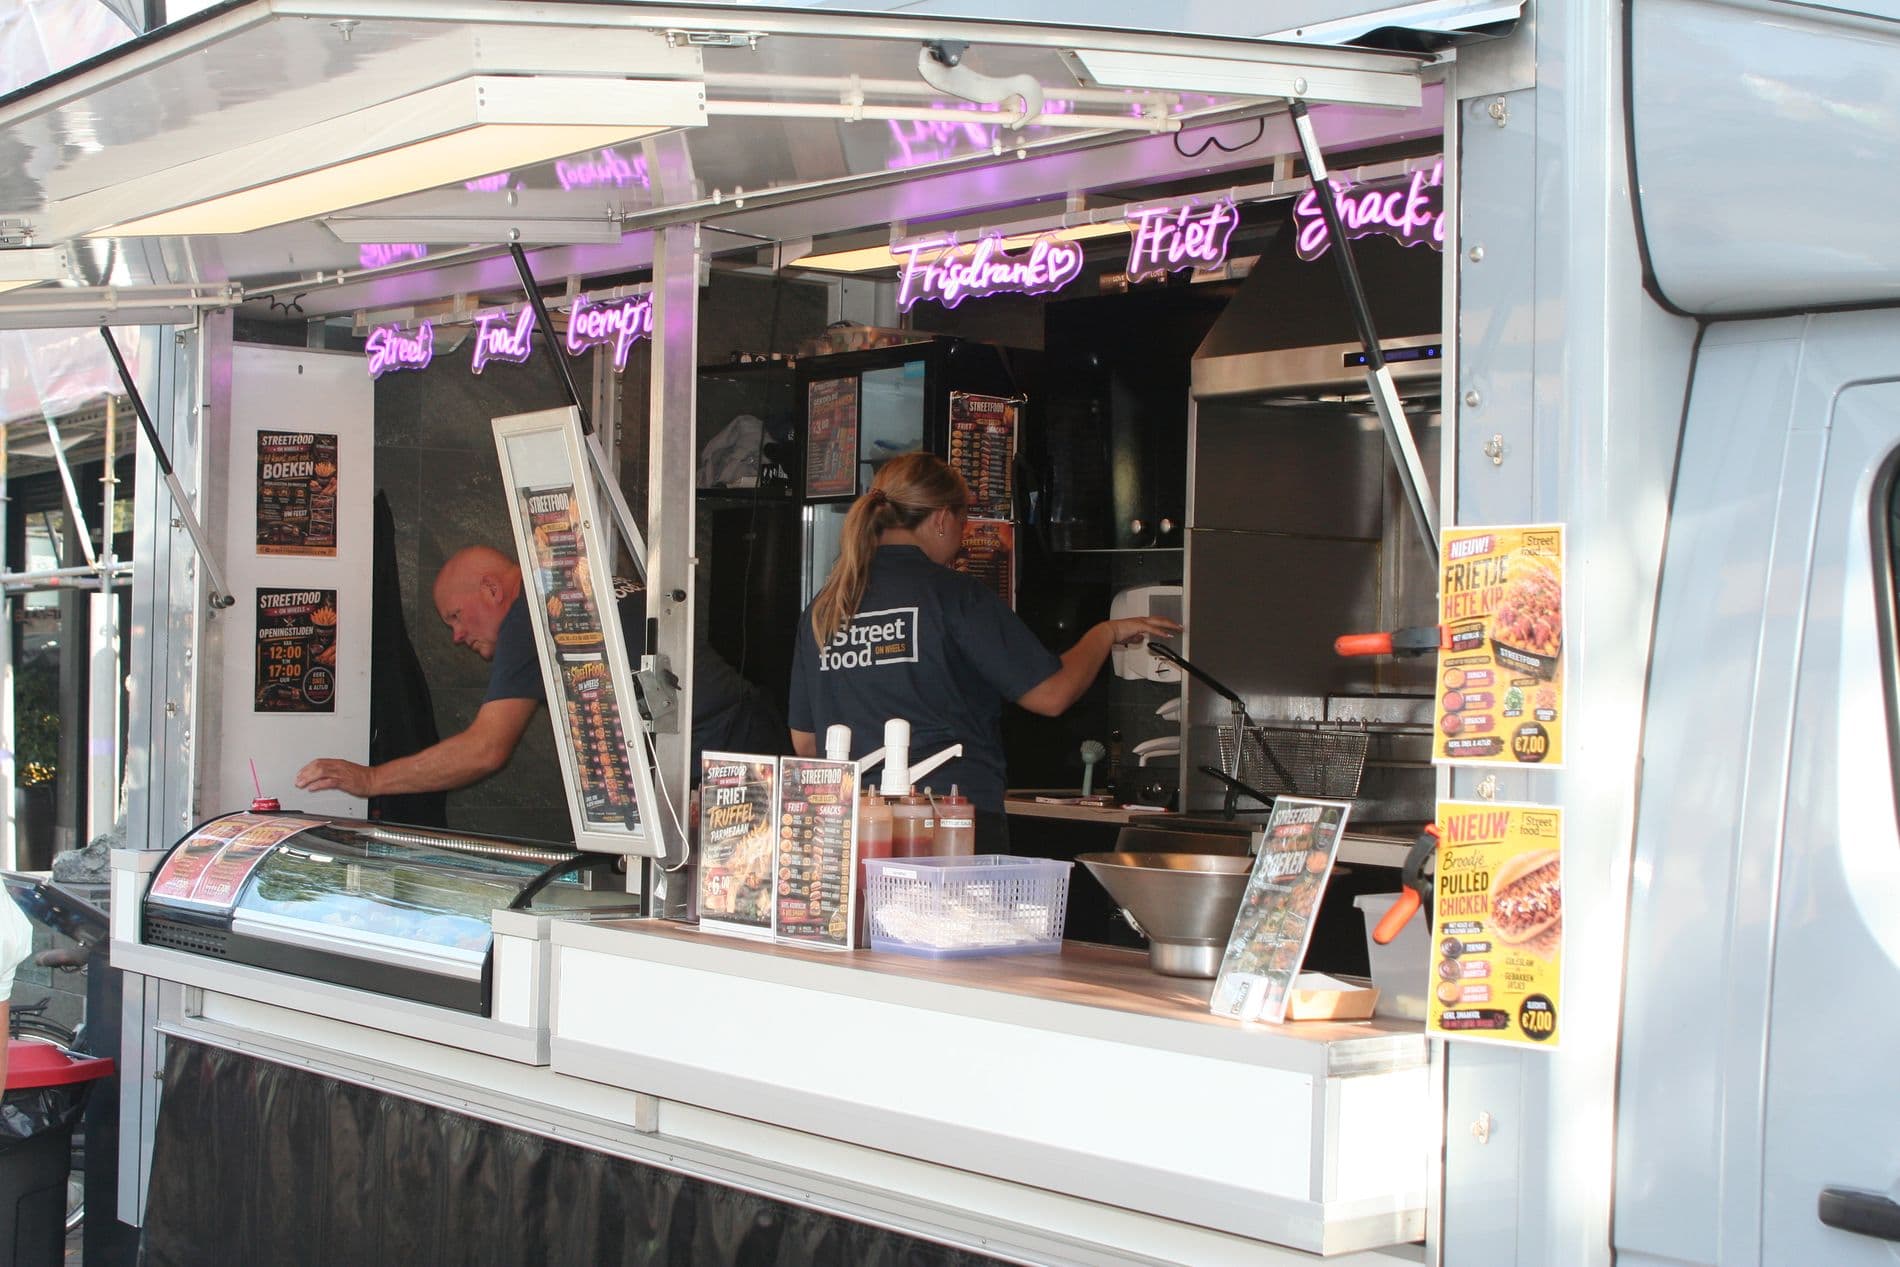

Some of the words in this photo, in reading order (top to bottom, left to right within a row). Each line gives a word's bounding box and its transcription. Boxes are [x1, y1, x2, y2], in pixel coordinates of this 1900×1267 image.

[1128, 204, 1230, 273] Friet
[892, 238, 1048, 304] Frisdrank
[473, 303, 533, 368] Food
[366, 323, 429, 373] Street
[969, 401, 1004, 413] STREETFOOD
[262, 434, 314, 446] STREETFOOD
[263, 461, 314, 480] BOEKEN
[529, 493, 569, 514] STREETFOOD
[1451, 536, 1489, 558] NIEUW!
[1527, 534, 1554, 550] Street
[1445, 555, 1509, 594] FRIETJE
[261, 592, 321, 609] STREETFOOD
[1445, 591, 1477, 618] HETE
[1481, 587, 1503, 612] KIP
[260, 627, 314, 639] OPENINGSTIJDEN
[833, 618, 905, 647] Street
[270, 646, 302, 659] 12:00
[819, 642, 872, 671] food
[875, 646, 885, 654] ON
[885, 643, 906, 653] WHEELS
[269, 664, 301, 677] 17:00
[1514, 736, 1545, 754] €7,00
[708, 766, 747, 779] STREETFOOD
[801, 768, 842, 784] STREETFOOD
[717, 787, 748, 806] FRIET
[707, 803, 755, 829] TRUFFEL
[787, 802, 804, 812] FRIET
[819, 806, 841, 816] SNACKS
[1448, 811, 1510, 842] NIEUW
[1520, 826, 1540, 836] food
[1527, 816, 1553, 829] Street
[710, 823, 750, 841] PARMEZAAN
[1442, 849, 1485, 872] Broodje
[1440, 872, 1488, 895] PULLED
[1440, 895, 1488, 917] CHICKEN
[1505, 958, 1534, 966] COLESLAW
[1505, 972, 1534, 982] GEBAKKEN
[1521, 1010, 1552, 1031] €7,00
